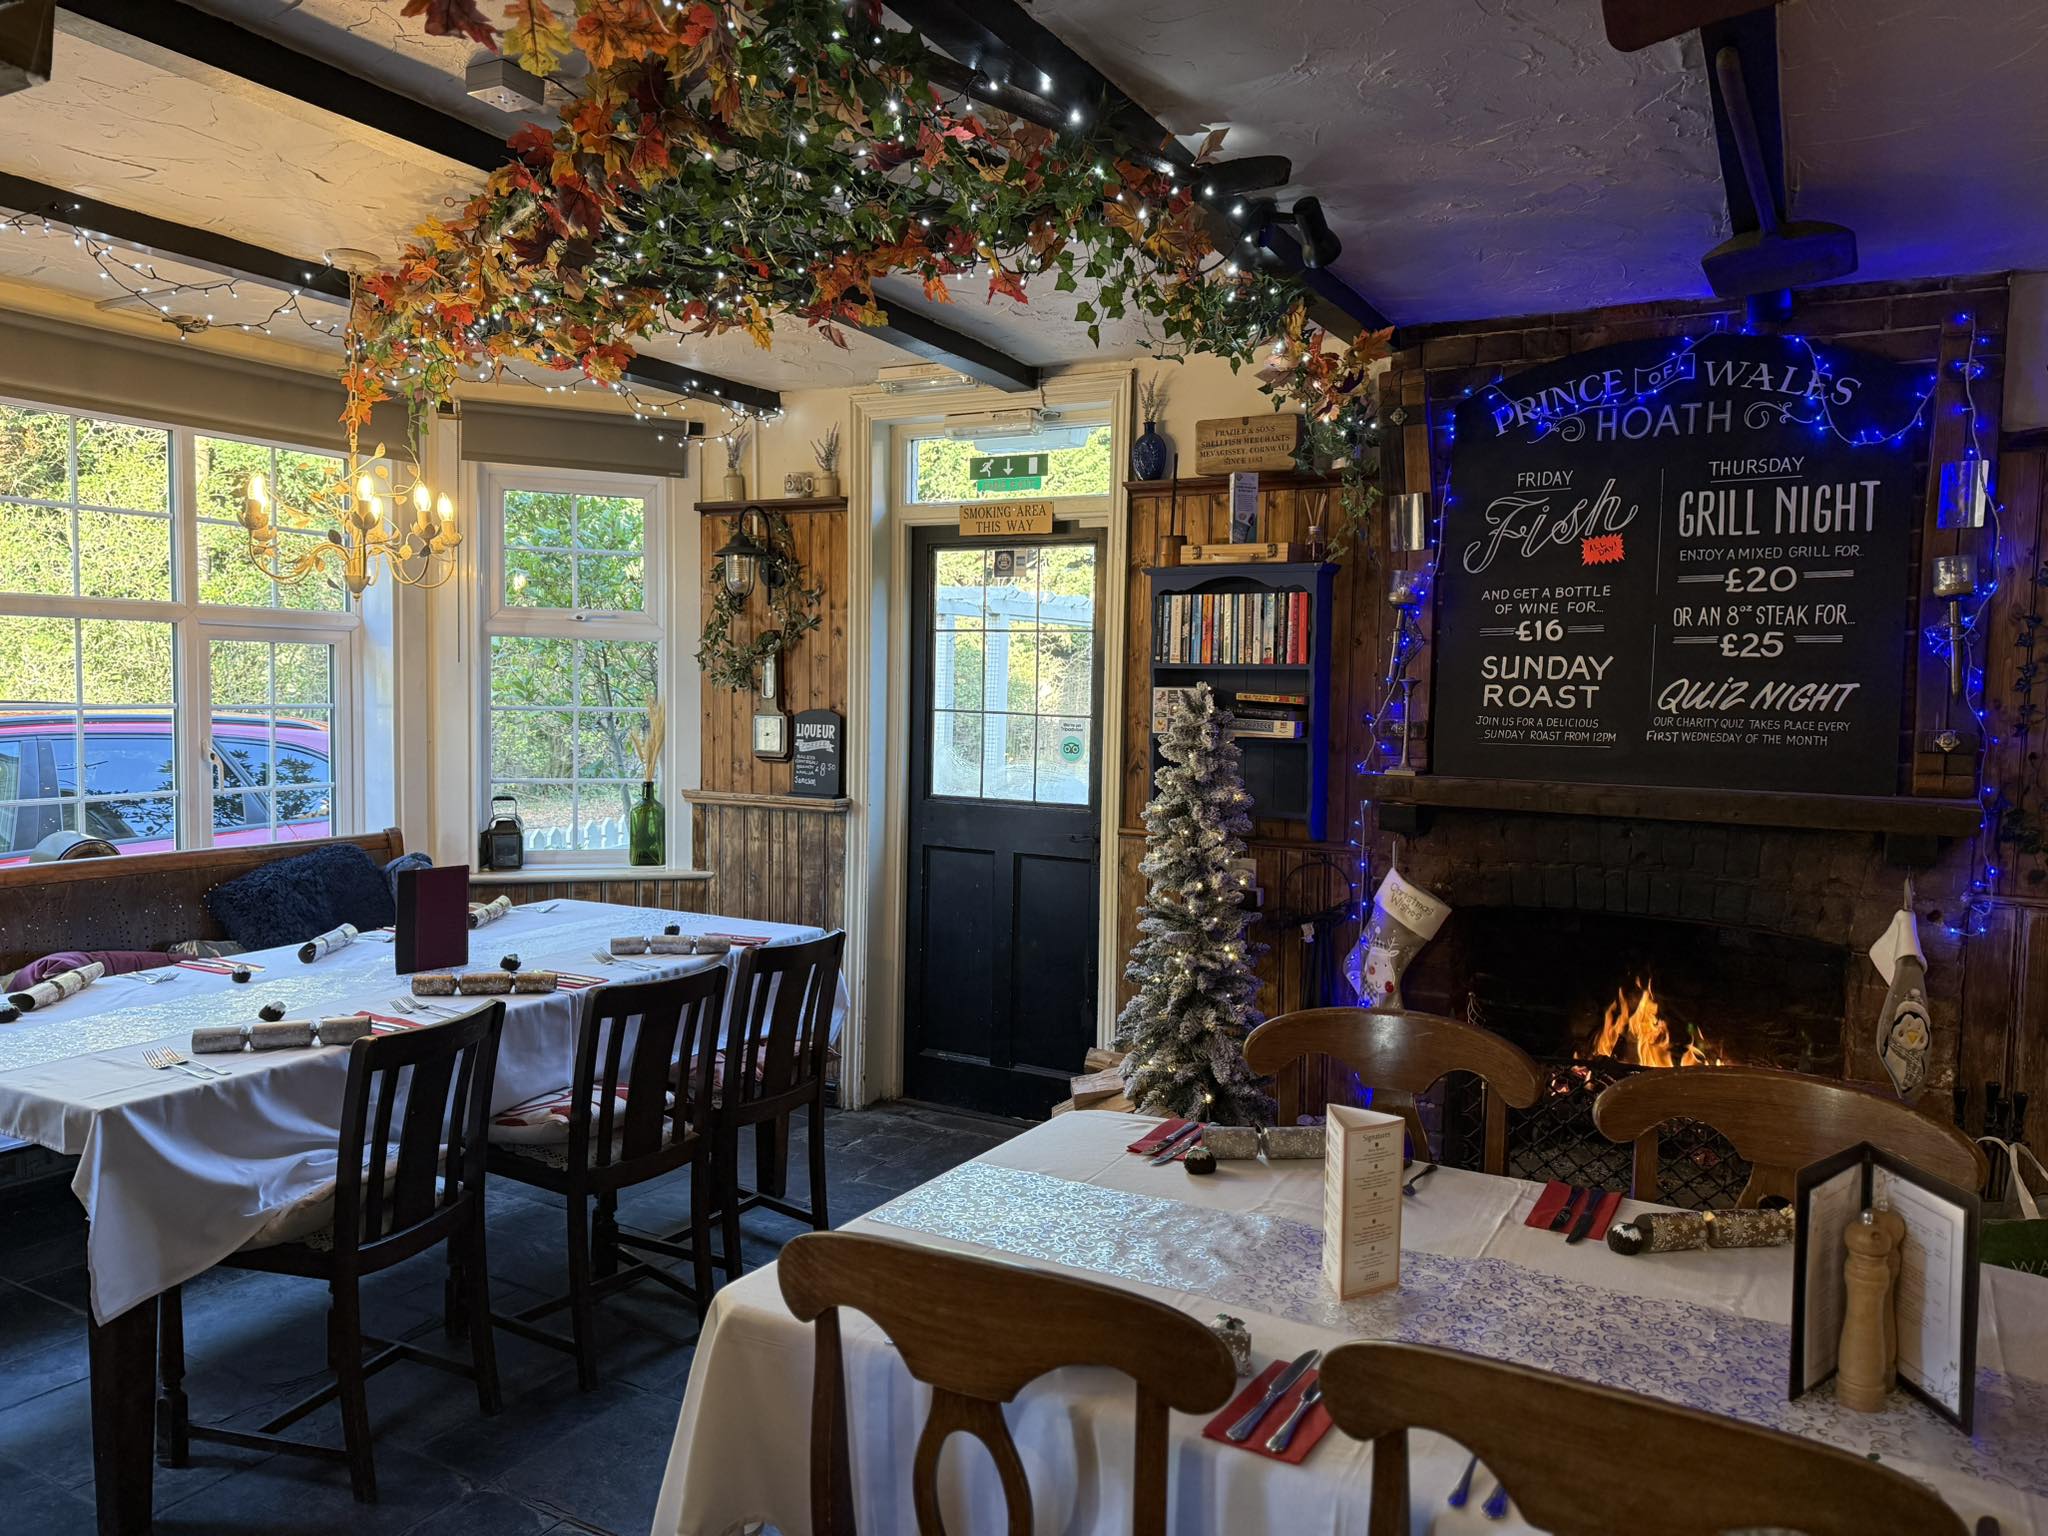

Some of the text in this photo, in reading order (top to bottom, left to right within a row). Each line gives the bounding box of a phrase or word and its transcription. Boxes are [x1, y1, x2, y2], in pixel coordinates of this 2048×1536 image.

[1491, 360, 1863, 438] PRINCE OF WALES
[1596, 400, 1733, 441] HOATH
[1255, 425, 1276, 434] SONS
[1200, 434, 1290, 449] SHELLFISH MERCHANTS
[1223, 456, 1248, 465] SINCE
[1708, 456, 1805, 477] THURSDAY
[1517, 470, 1574, 488] FRIDAY
[963, 504, 1047, 520] SMOKING AREA
[1678, 480, 1881, 538] GRILL NIGHT
[976, 519, 1034, 533] THIS WAY
[1463, 478, 1639, 574] Fish
[1589, 542, 1607, 553] ALL
[1679, 549, 1724, 562] ENJOY
[1727, 549, 1737, 561] A
[1737, 546, 1783, 560] MIXED
[1788, 545, 1831, 558] GRILL
[1724, 565, 1798, 593] £20
[1481, 585, 1612, 601] AND GET A BOTTLE
[1494, 603, 1513, 615] OF
[1519, 602, 1560, 615] WINE
[1673, 606, 1693, 628] OR
[1697, 606, 1721, 627] AN
[1755, 604, 1809, 627] STEAK
[1515, 619, 1564, 642] £16
[1719, 631, 1785, 658] £25
[1480, 655, 1615, 681] SUNDAY
[1483, 684, 1600, 709] ROAST
[1750, 680, 1861, 713] NIGHT
[1475, 715, 1600, 729] JOIN US FOR A DELICIOUS
[1653, 716, 1851, 732] OUR CHARITY QUIZ TAKES PLACE EVERY
[796, 723, 836, 740] LIQUEUR
[1484, 729, 1617, 743] SUNDAY ROAST FROM 12PM
[1646, 730, 1828, 746] FIRST WEDNESDAY OF THE MONTH
